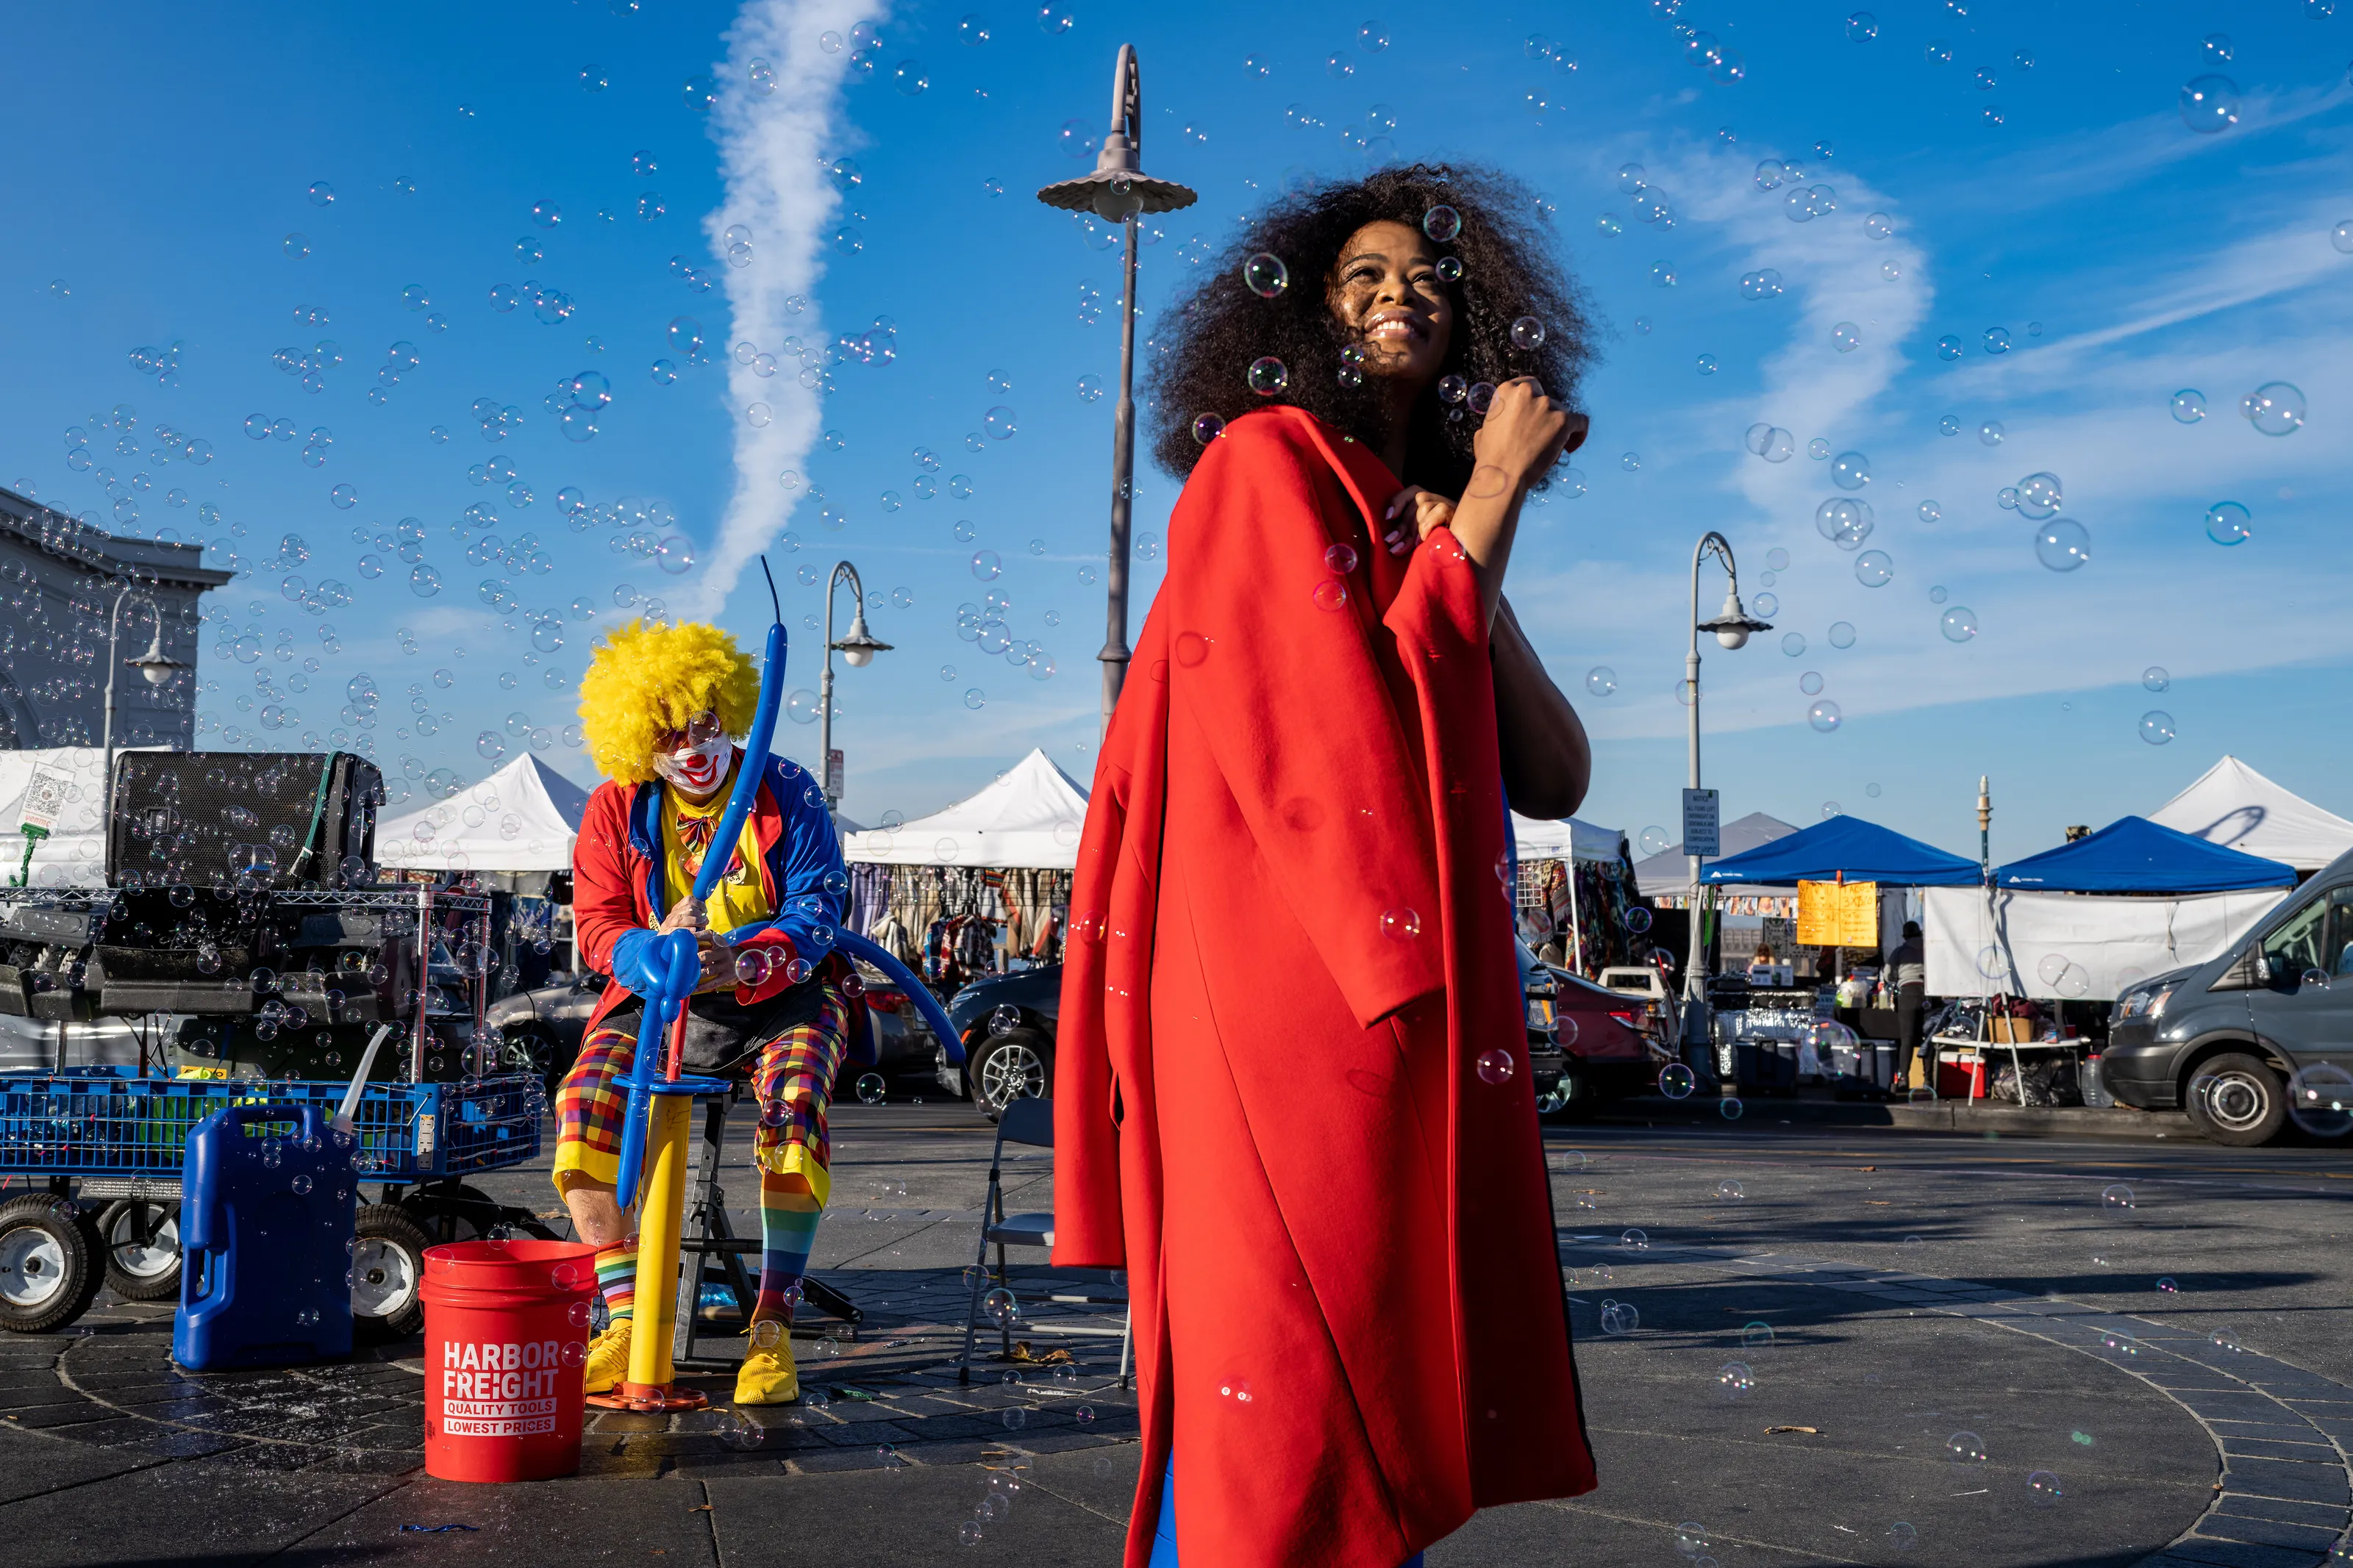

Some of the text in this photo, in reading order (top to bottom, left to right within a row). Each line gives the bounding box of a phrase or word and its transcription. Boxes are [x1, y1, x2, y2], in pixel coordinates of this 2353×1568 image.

[444, 1341, 559, 1370] HARBOR
[443, 1369, 559, 1400] FREIGHT
[448, 1400, 552, 1415] QUALITY TOOLS
[448, 1420, 499, 1433] LOWEST
[504, 1419, 551, 1433] PRICES
